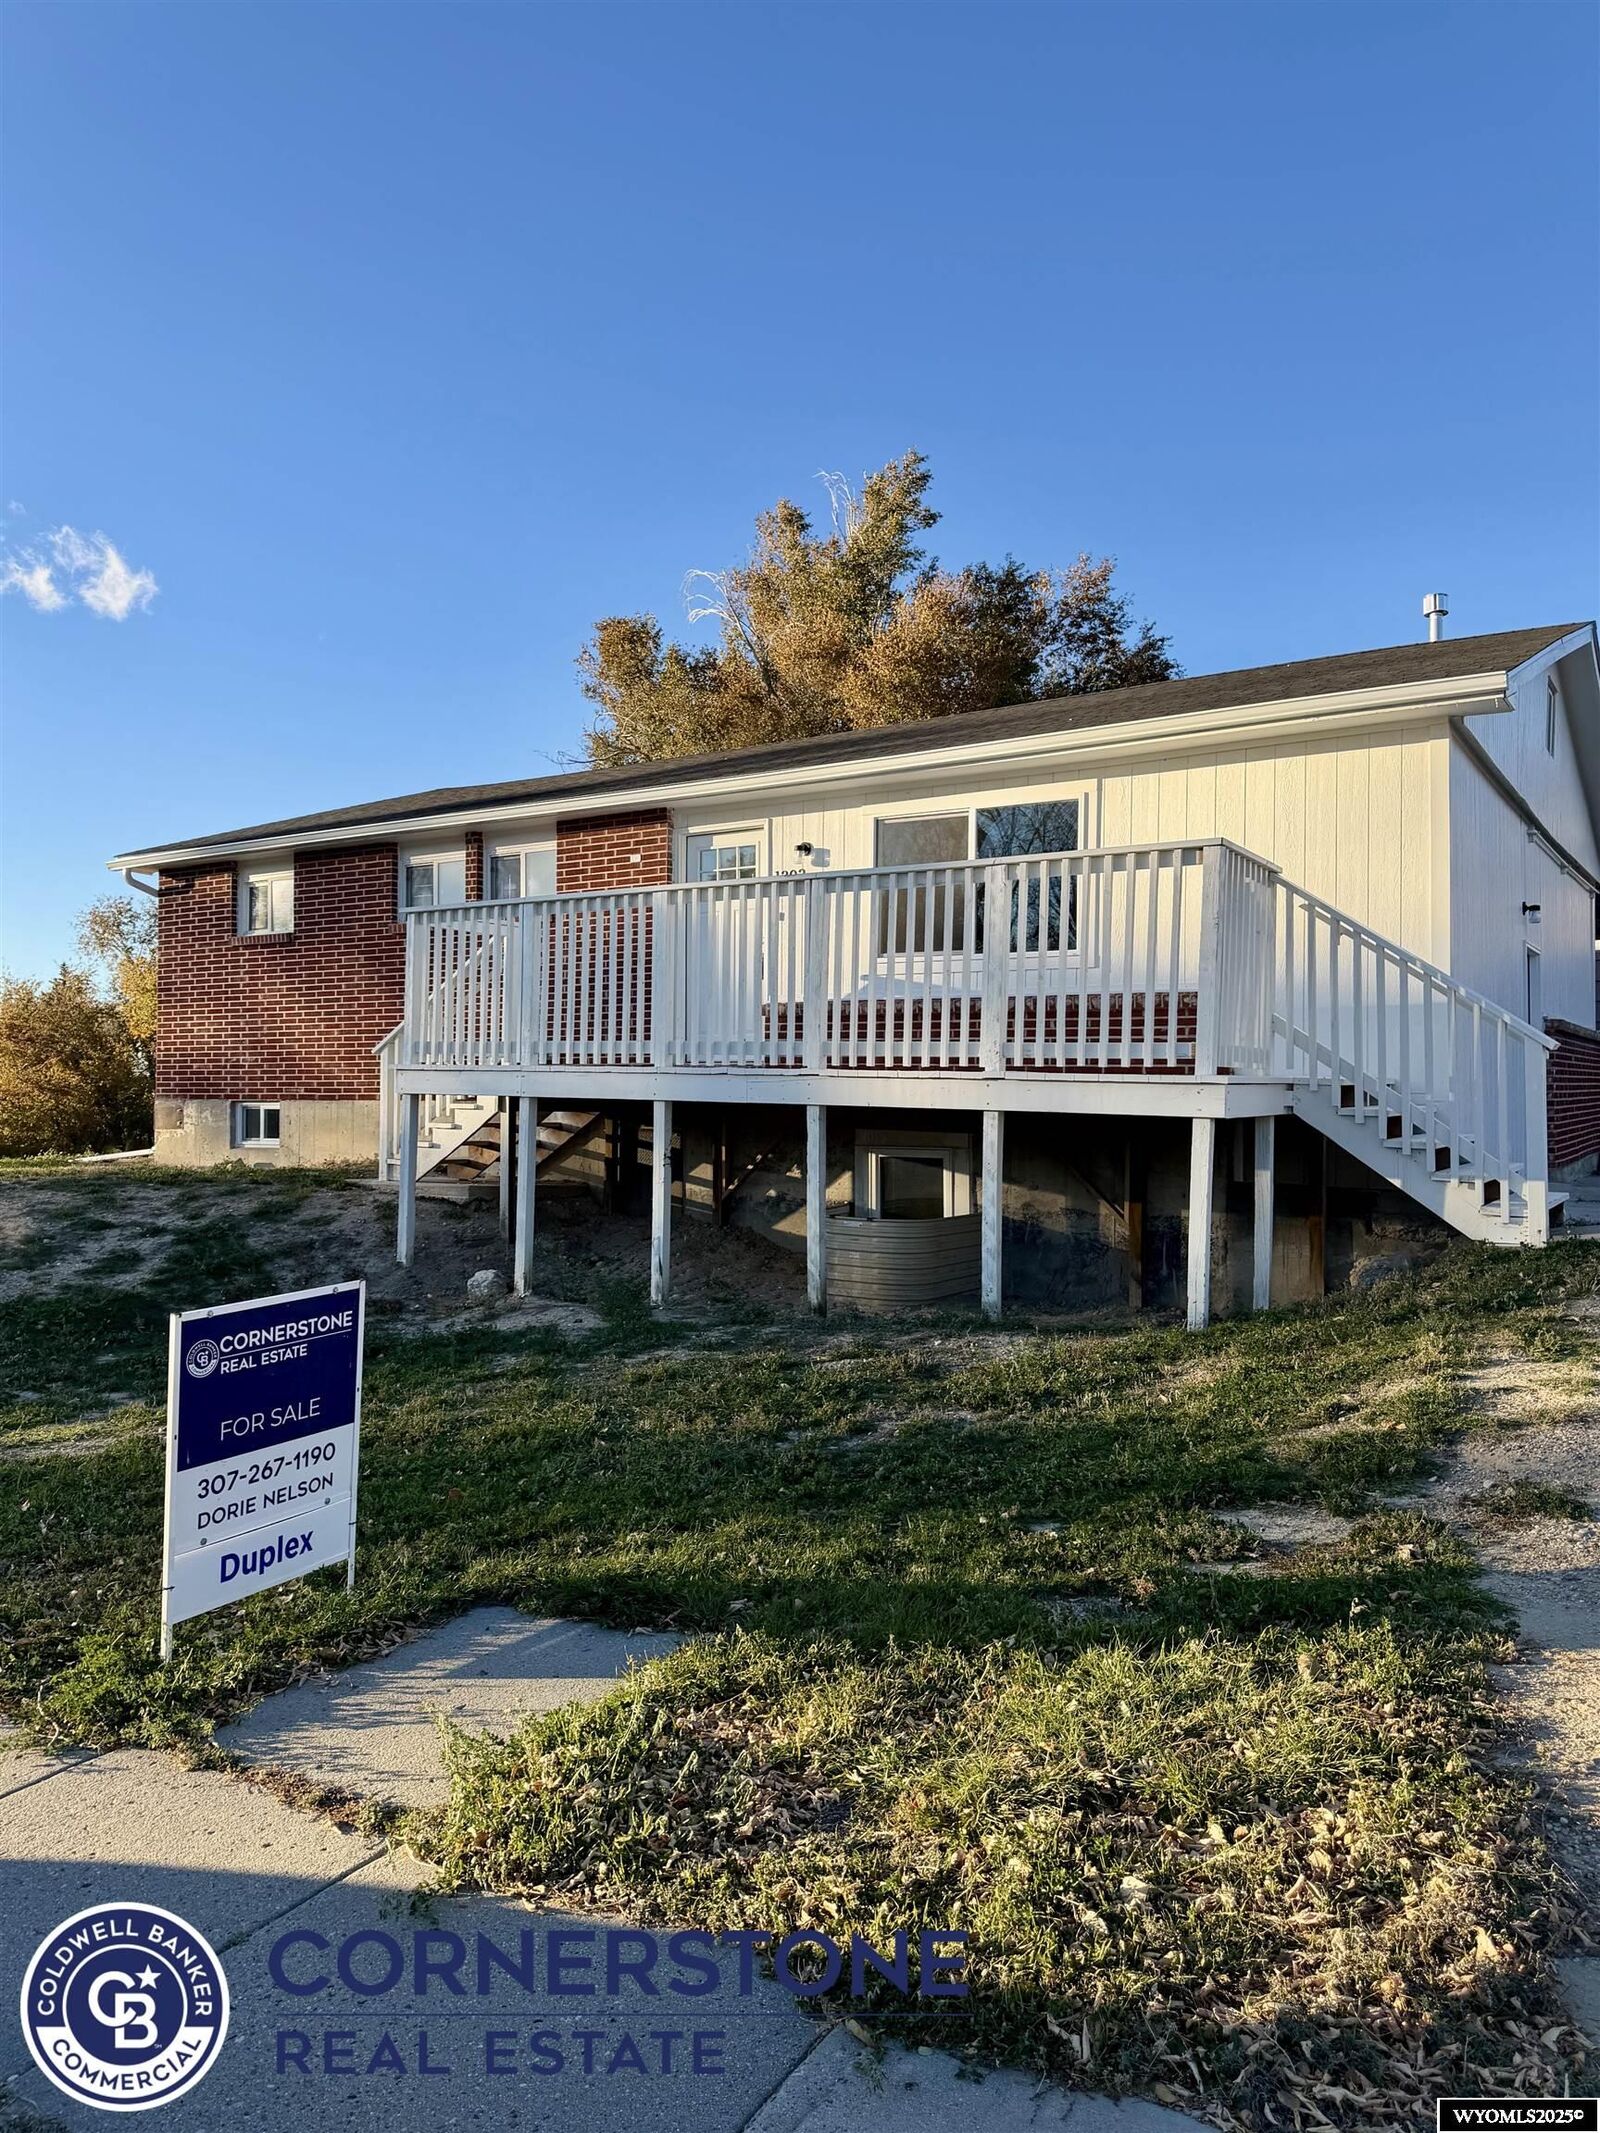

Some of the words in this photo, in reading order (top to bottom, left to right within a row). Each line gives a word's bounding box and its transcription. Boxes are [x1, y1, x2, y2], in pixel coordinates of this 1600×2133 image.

[219, 1310, 353, 1353] CORNERSTONE
[220, 1355, 257, 1375] REAL
[261, 1343, 308, 1366] ESTATE
[220, 1412, 265, 1442] FOR
[270, 1397, 321, 1427] SALE
[197, 1442, 336, 1499] 307-267-1190
[197, 1496, 257, 1530] DORIE
[263, 1472, 334, 1509] NELSON
[220, 1530, 314, 1584] Duplex
